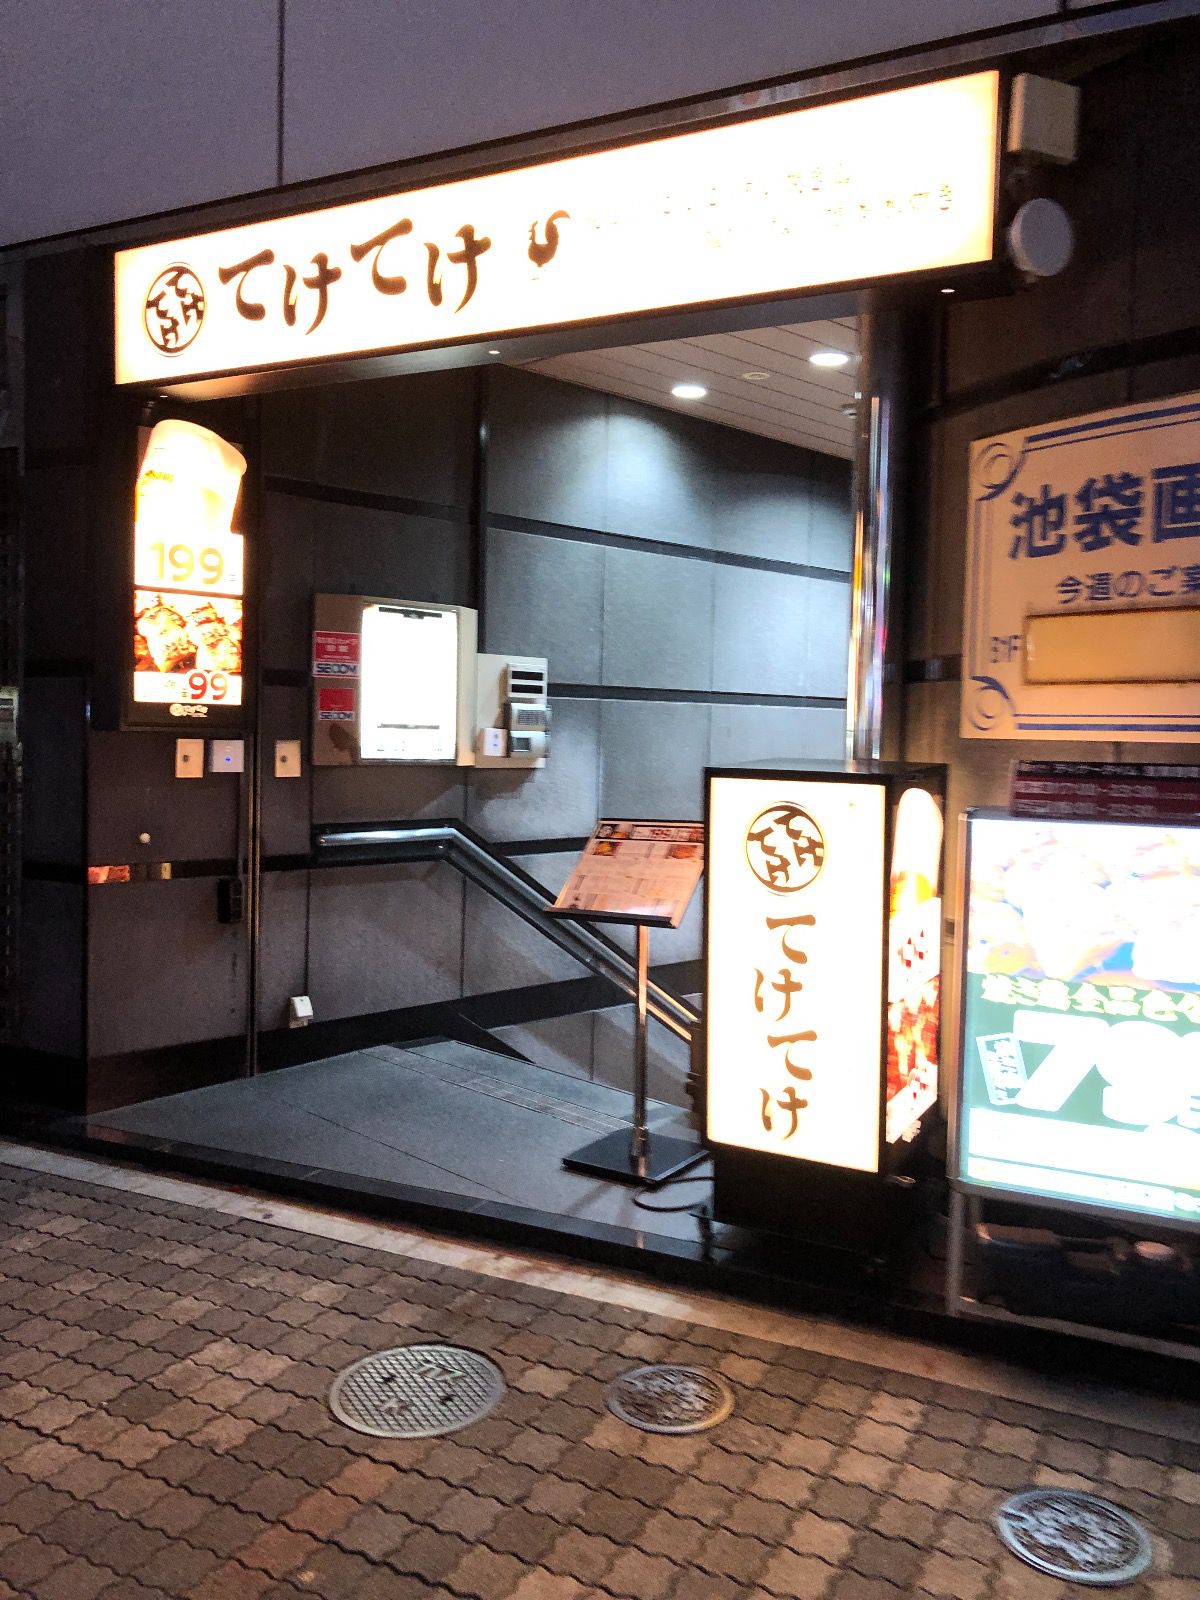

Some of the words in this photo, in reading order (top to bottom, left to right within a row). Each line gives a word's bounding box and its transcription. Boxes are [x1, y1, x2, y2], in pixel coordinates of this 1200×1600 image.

[218, 217, 492, 335] てけてけ
[150, 542, 225, 585] 199
[316, 662, 357, 675] SECOM
[754, 913, 819, 1141] てけてけ
